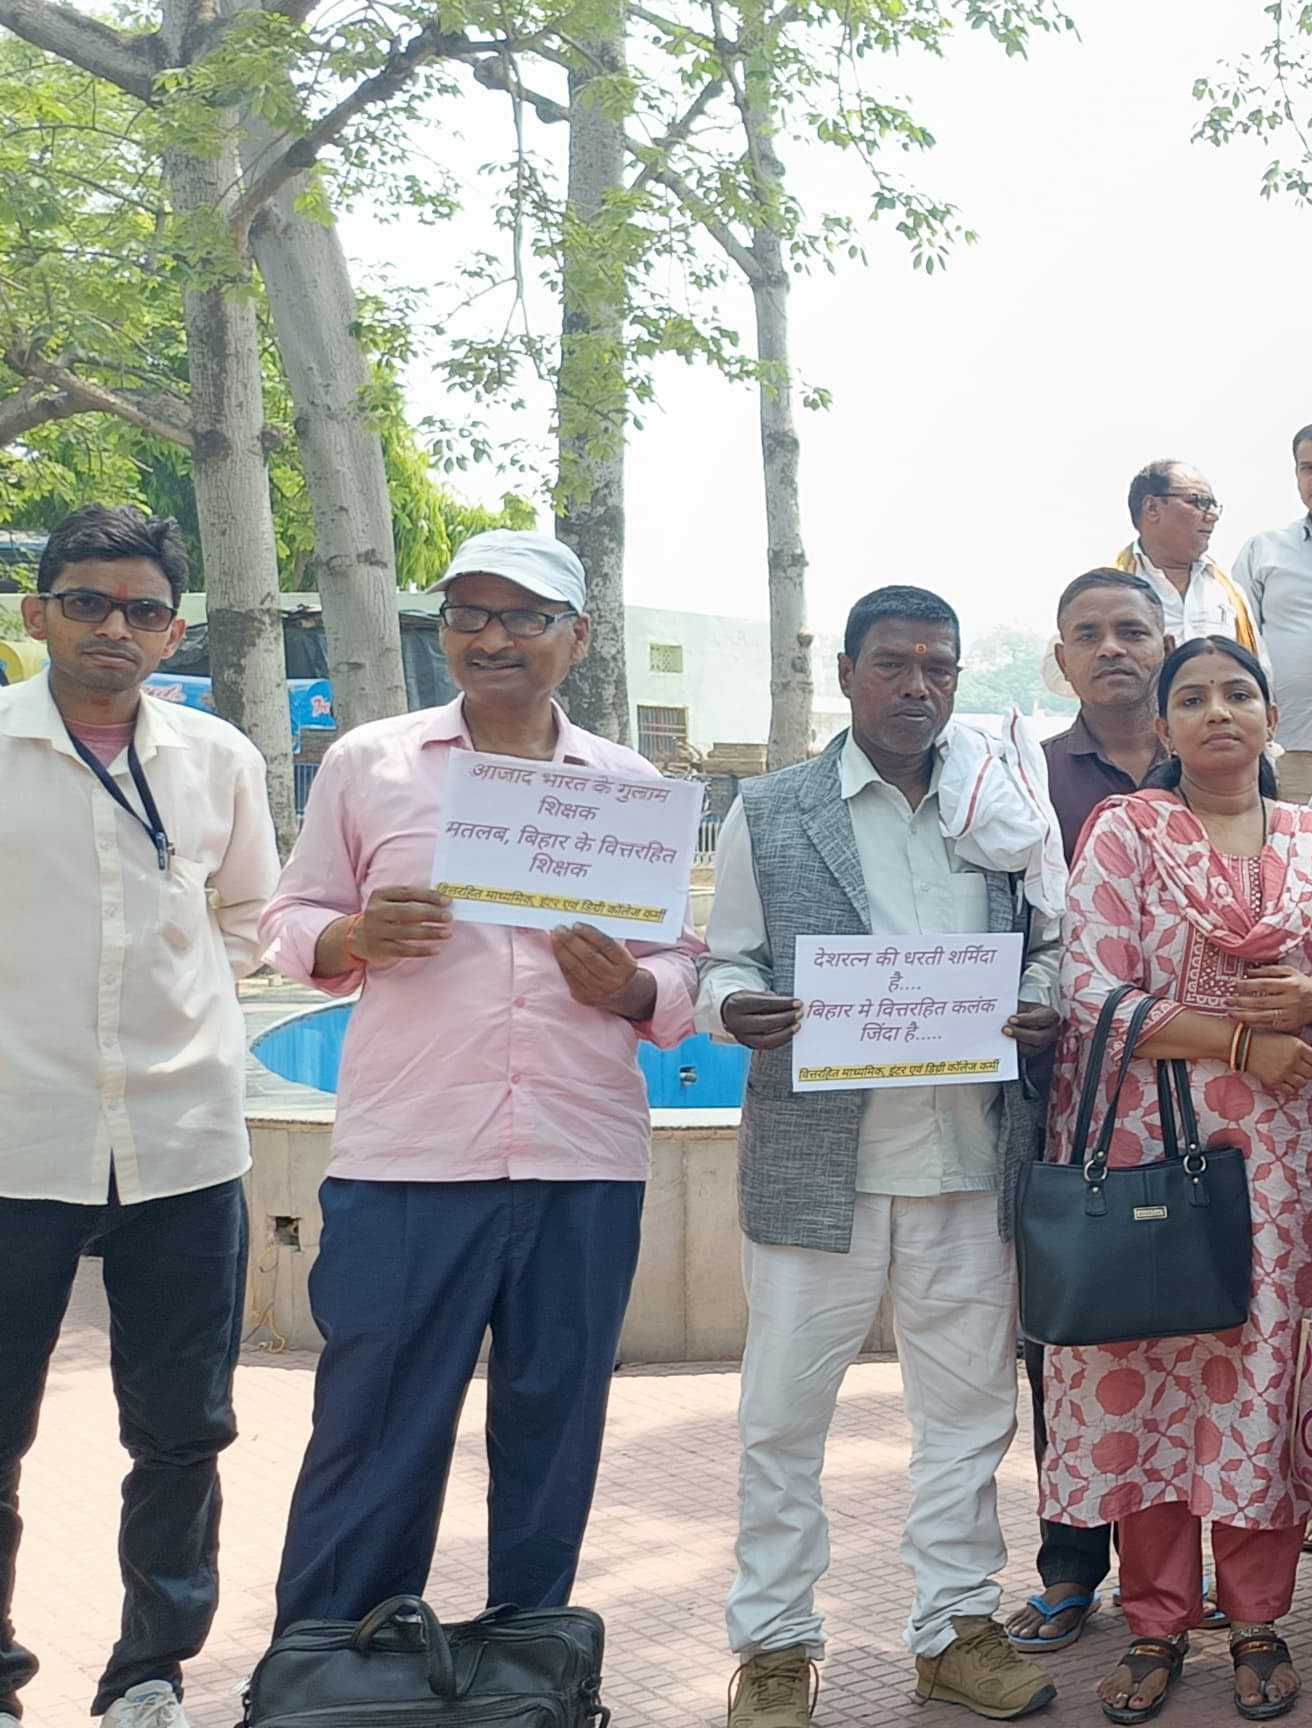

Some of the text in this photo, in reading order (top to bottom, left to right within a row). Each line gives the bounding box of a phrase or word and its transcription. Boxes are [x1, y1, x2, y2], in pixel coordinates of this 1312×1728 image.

[469, 762, 535, 787] आजाद
[542, 769, 587, 793] भारत
[592, 772, 615, 796] के
[537, 795, 600, 822] शिक्षक
[517, 824, 571, 853] बिहार
[574, 831, 596, 853] के
[597, 835, 678, 865] वित्तरहित
[528, 852, 592, 879] शिक्षक
[813, 947, 872, 968] देशरत्न
[875, 945, 900, 967] की
[903, 945, 945, 966] धरती
[805, 1000, 853, 1020] बिहार
[876, 997, 949, 1020] वित्तरहित
[951, 995, 998, 1015] कलंक
[859, 1021, 901, 1042] जिंदा
